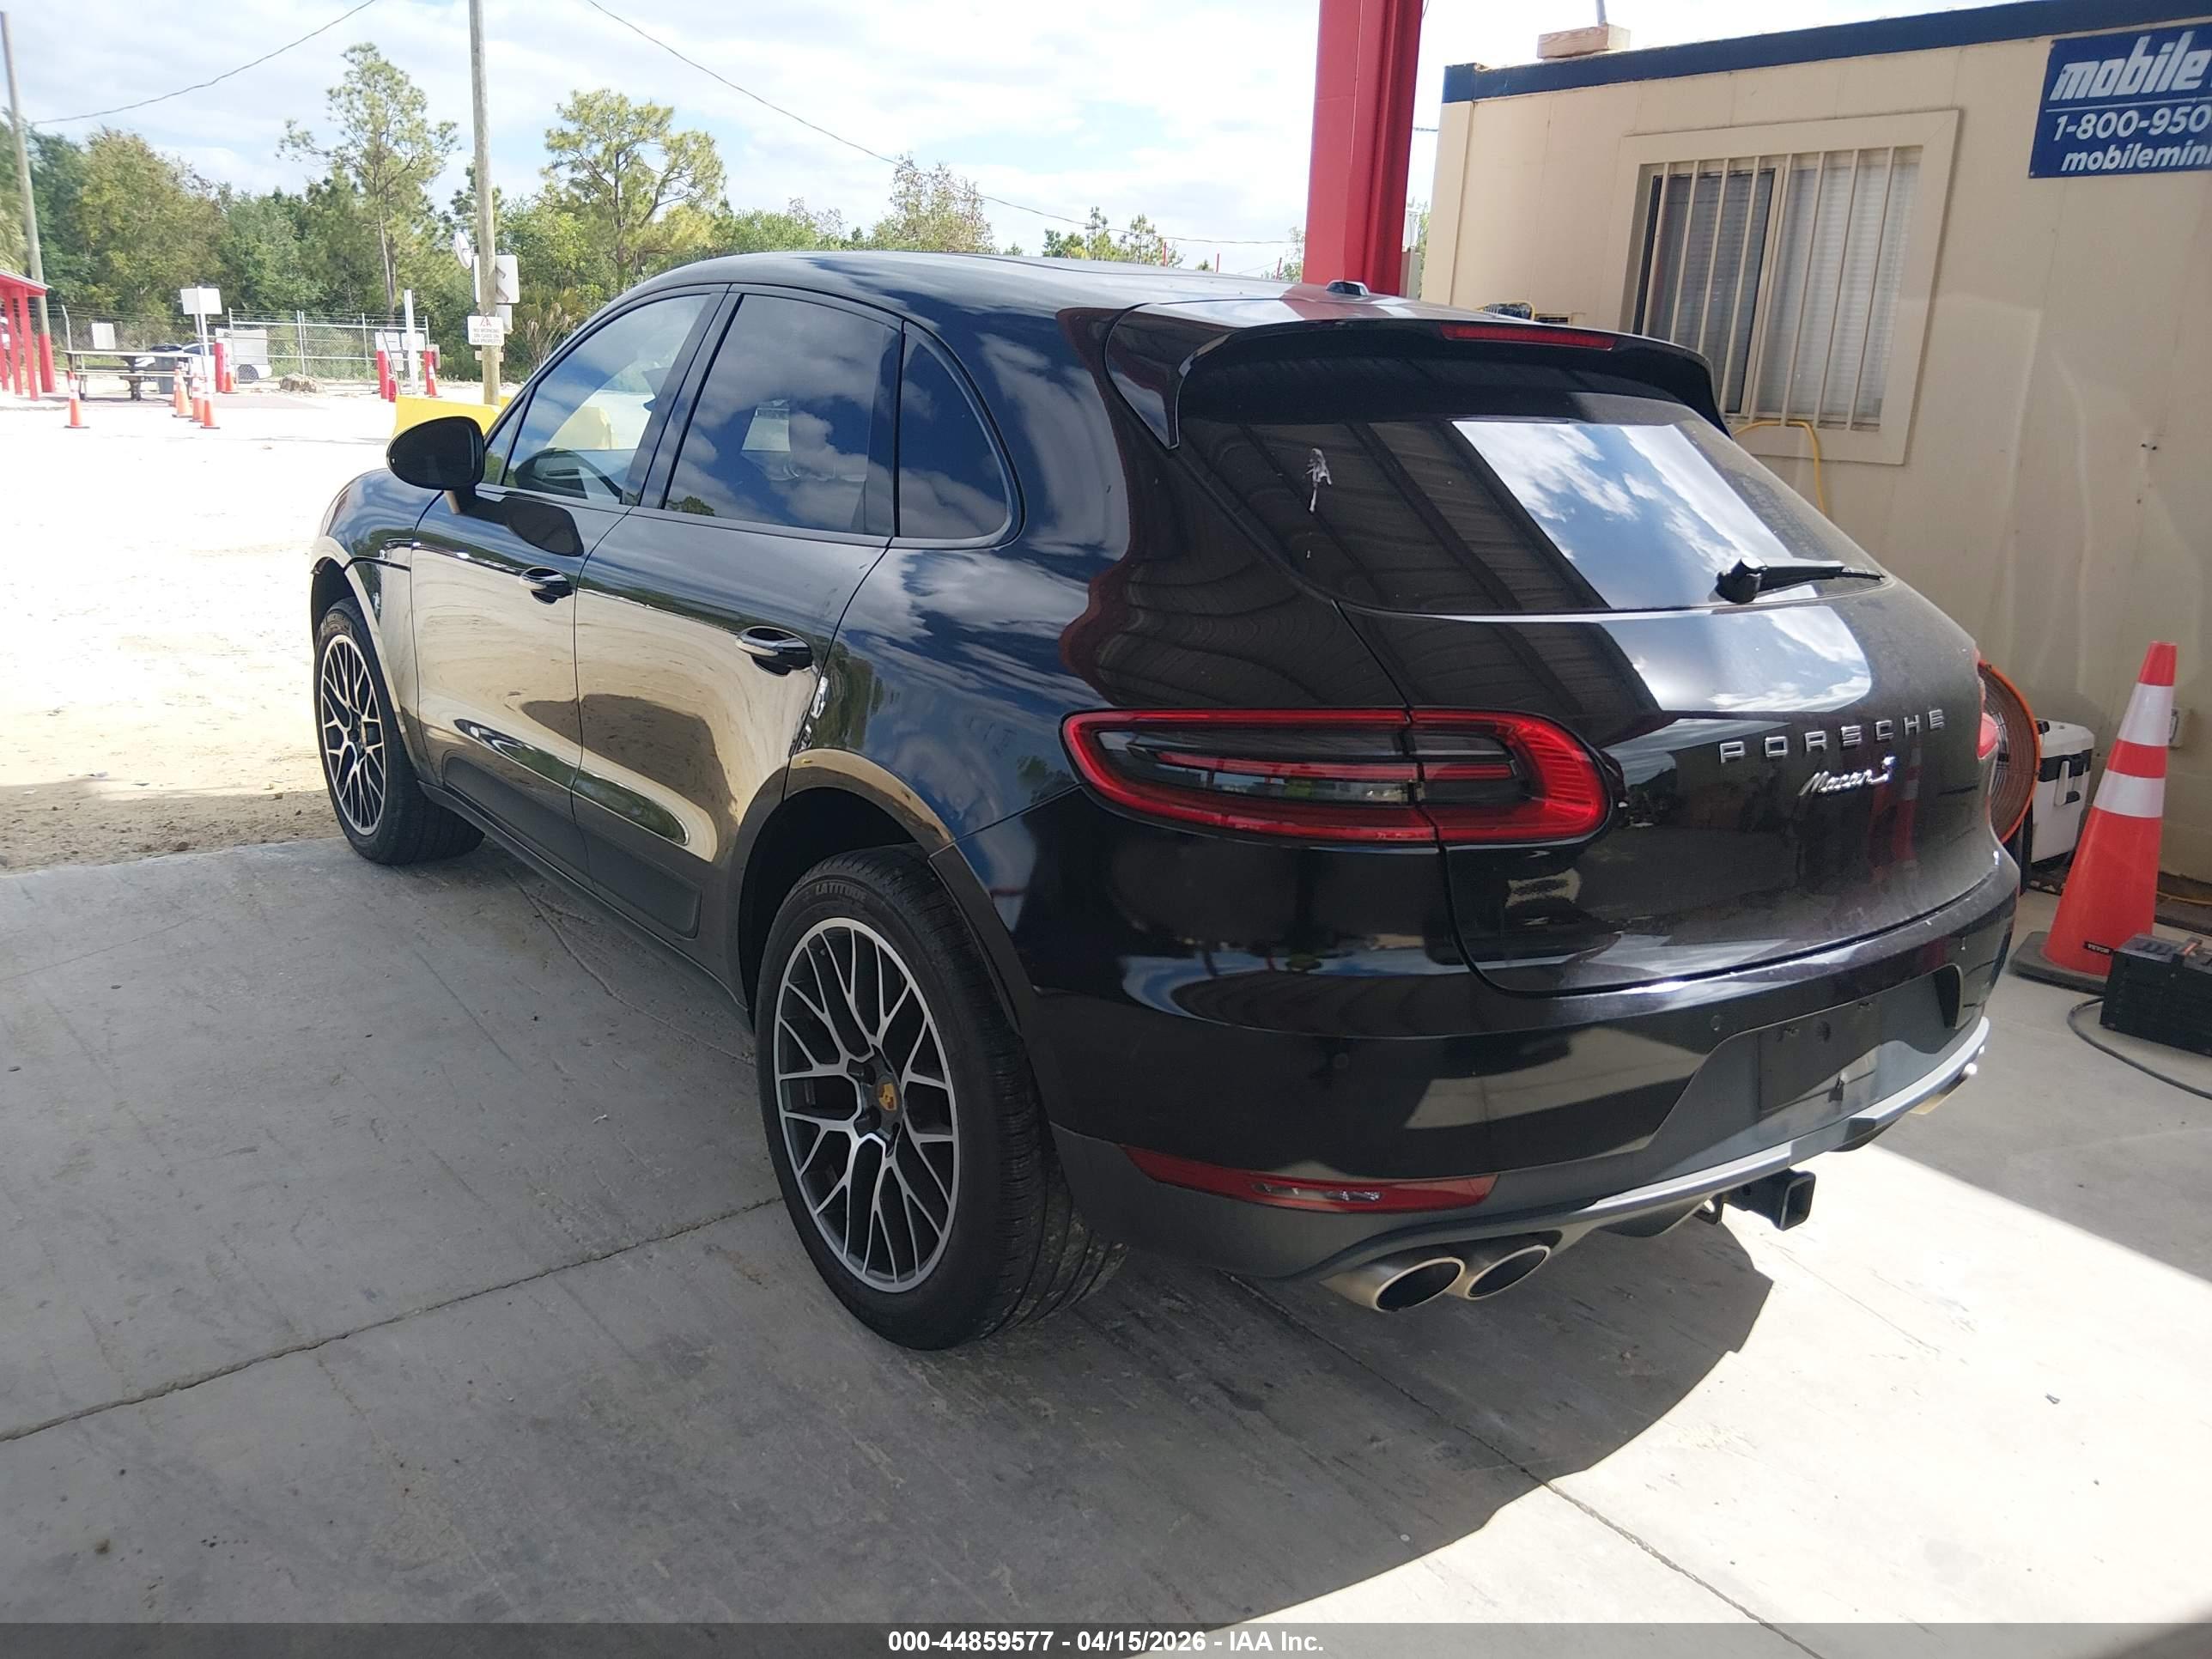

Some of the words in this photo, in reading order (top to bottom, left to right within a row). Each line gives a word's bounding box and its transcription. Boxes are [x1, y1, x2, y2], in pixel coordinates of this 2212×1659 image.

[2049, 31, 2212, 101] mobile
[1719, 708, 1944, 763] PORSCHE
[1797, 769, 1873, 797] Macan
[816, 881, 866, 902] LATITUDE
